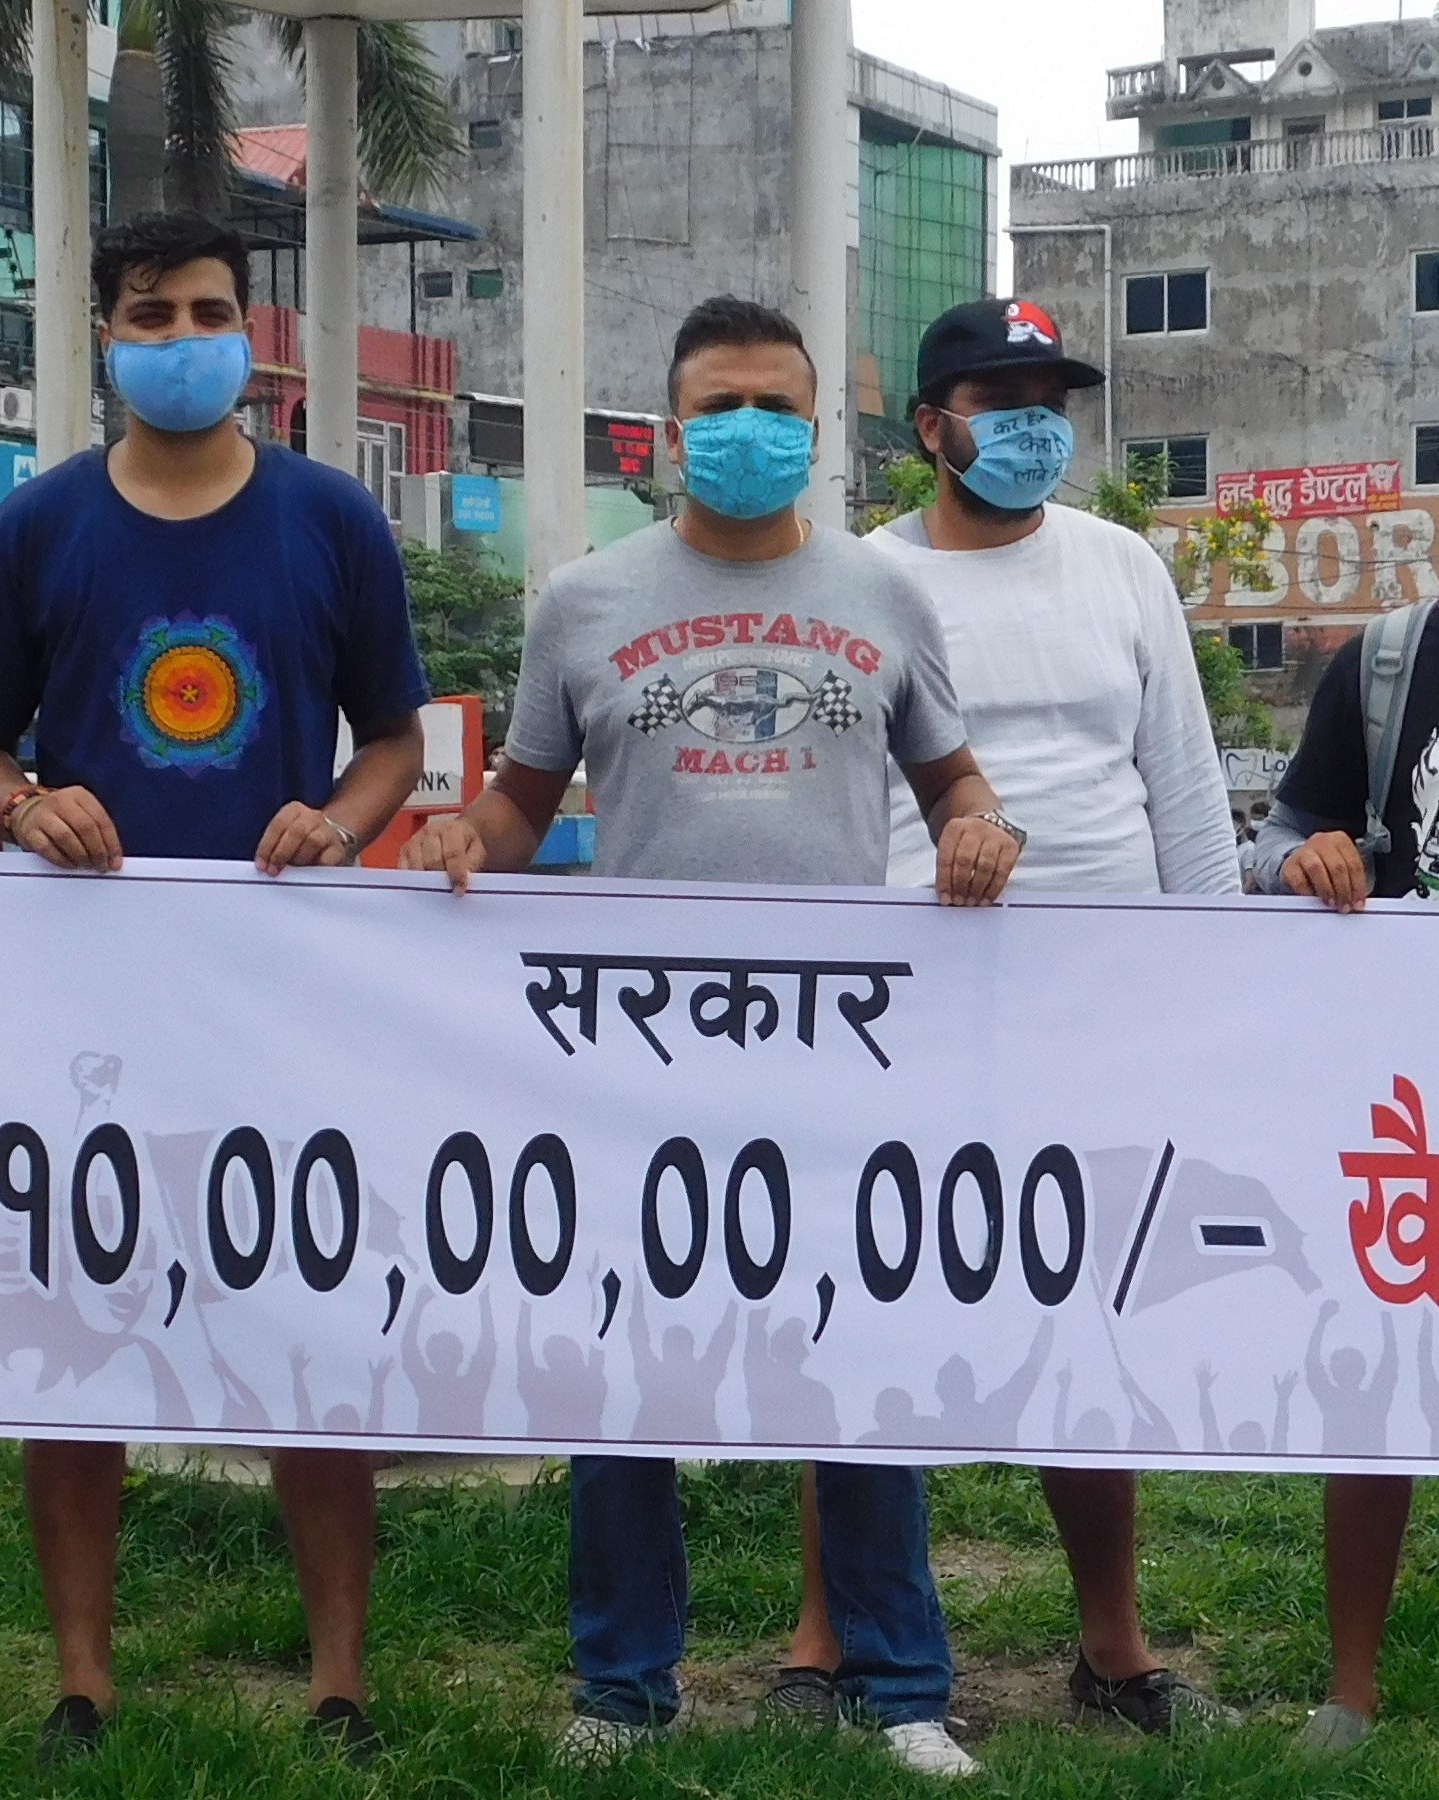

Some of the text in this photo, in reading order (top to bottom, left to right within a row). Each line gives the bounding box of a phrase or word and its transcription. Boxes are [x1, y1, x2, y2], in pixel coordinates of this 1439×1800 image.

[608, 612, 882, 682] MUSTANG
[413, 771, 450, 792] NK
[672, 746, 817, 774] MACH 1
[519, 951, 914, 1071] सरकार
